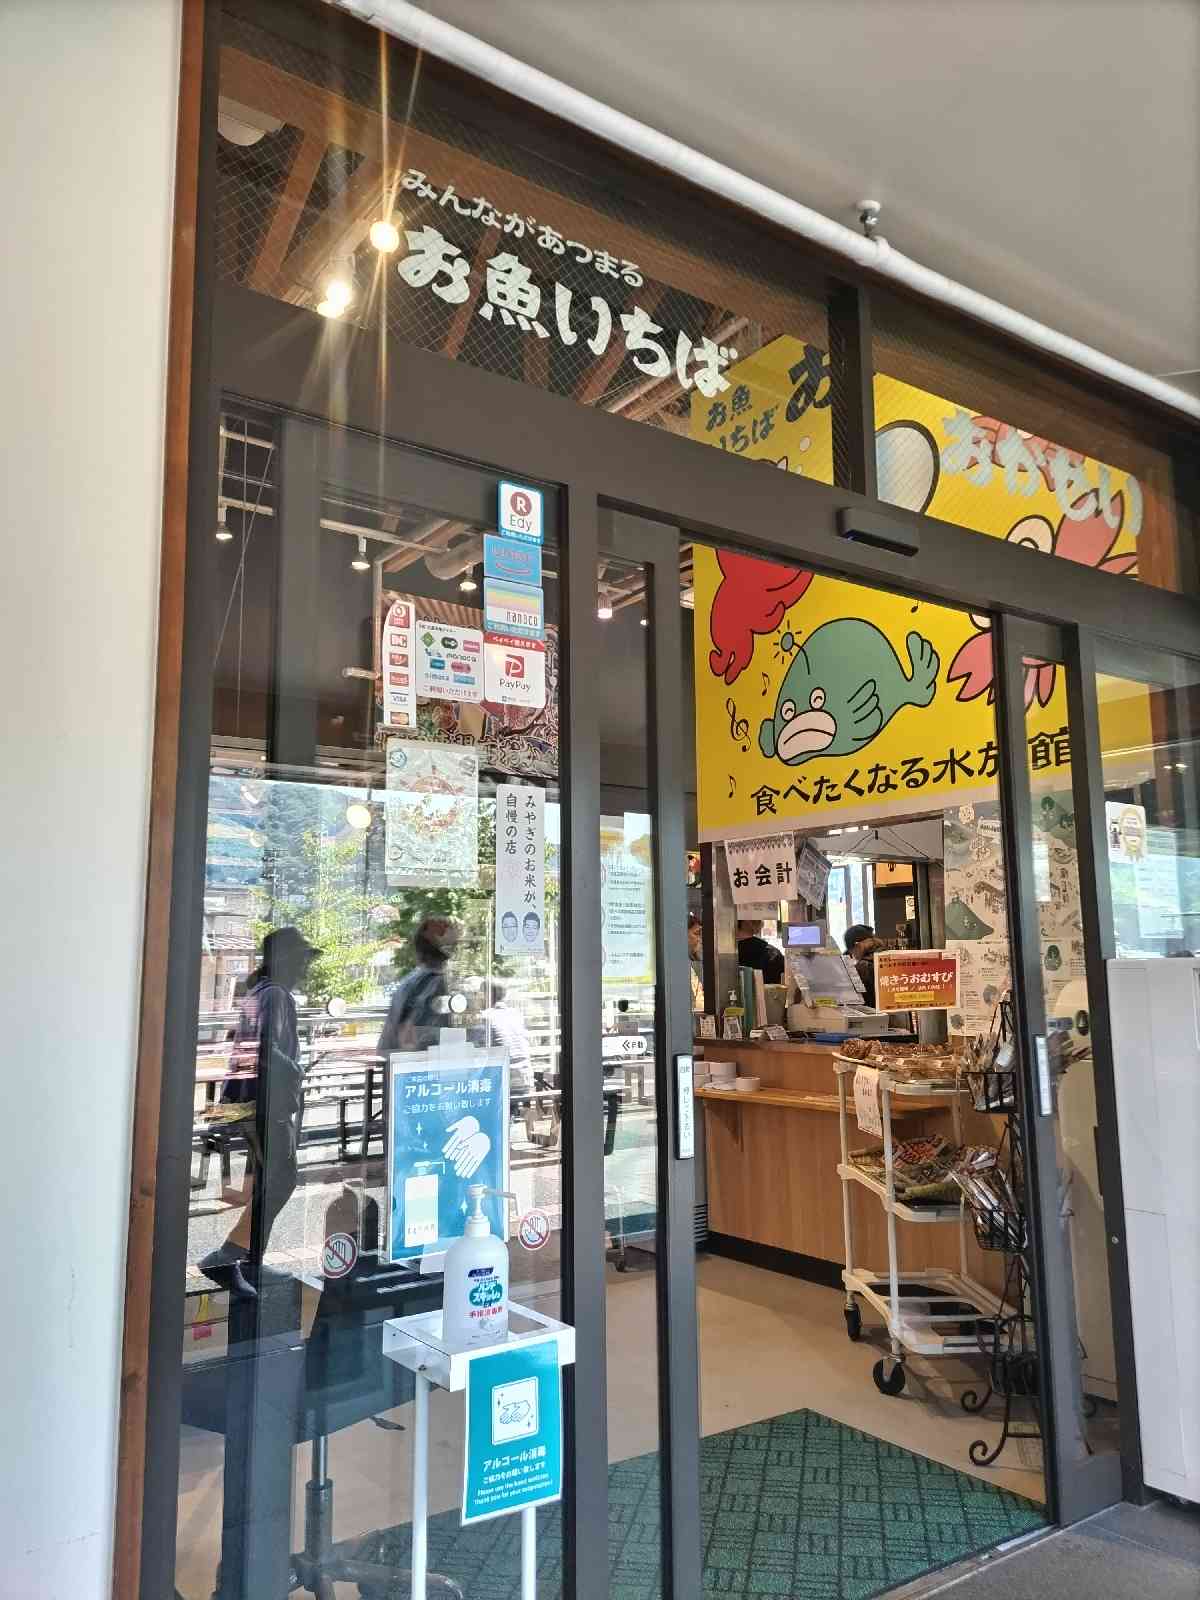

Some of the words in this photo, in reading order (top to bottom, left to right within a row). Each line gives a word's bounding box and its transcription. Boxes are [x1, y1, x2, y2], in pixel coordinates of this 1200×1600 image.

[402, 168, 643, 287] みんながあつまる
[397, 225, 738, 398] お魚いちば
[705, 384, 752, 432] お魚
[942, 408, 1144, 537] おかせい
[509, 514, 532, 532] Edy
[506, 611, 539, 627] nanaco
[499, 678, 531, 692] PayPay
[505, 793, 518, 855] 自慢の店
[733, 861, 793, 888] お会計
[404, 1078, 492, 1099] アルコール消毒
[482, 1445, 547, 1473] アルコール消毒
